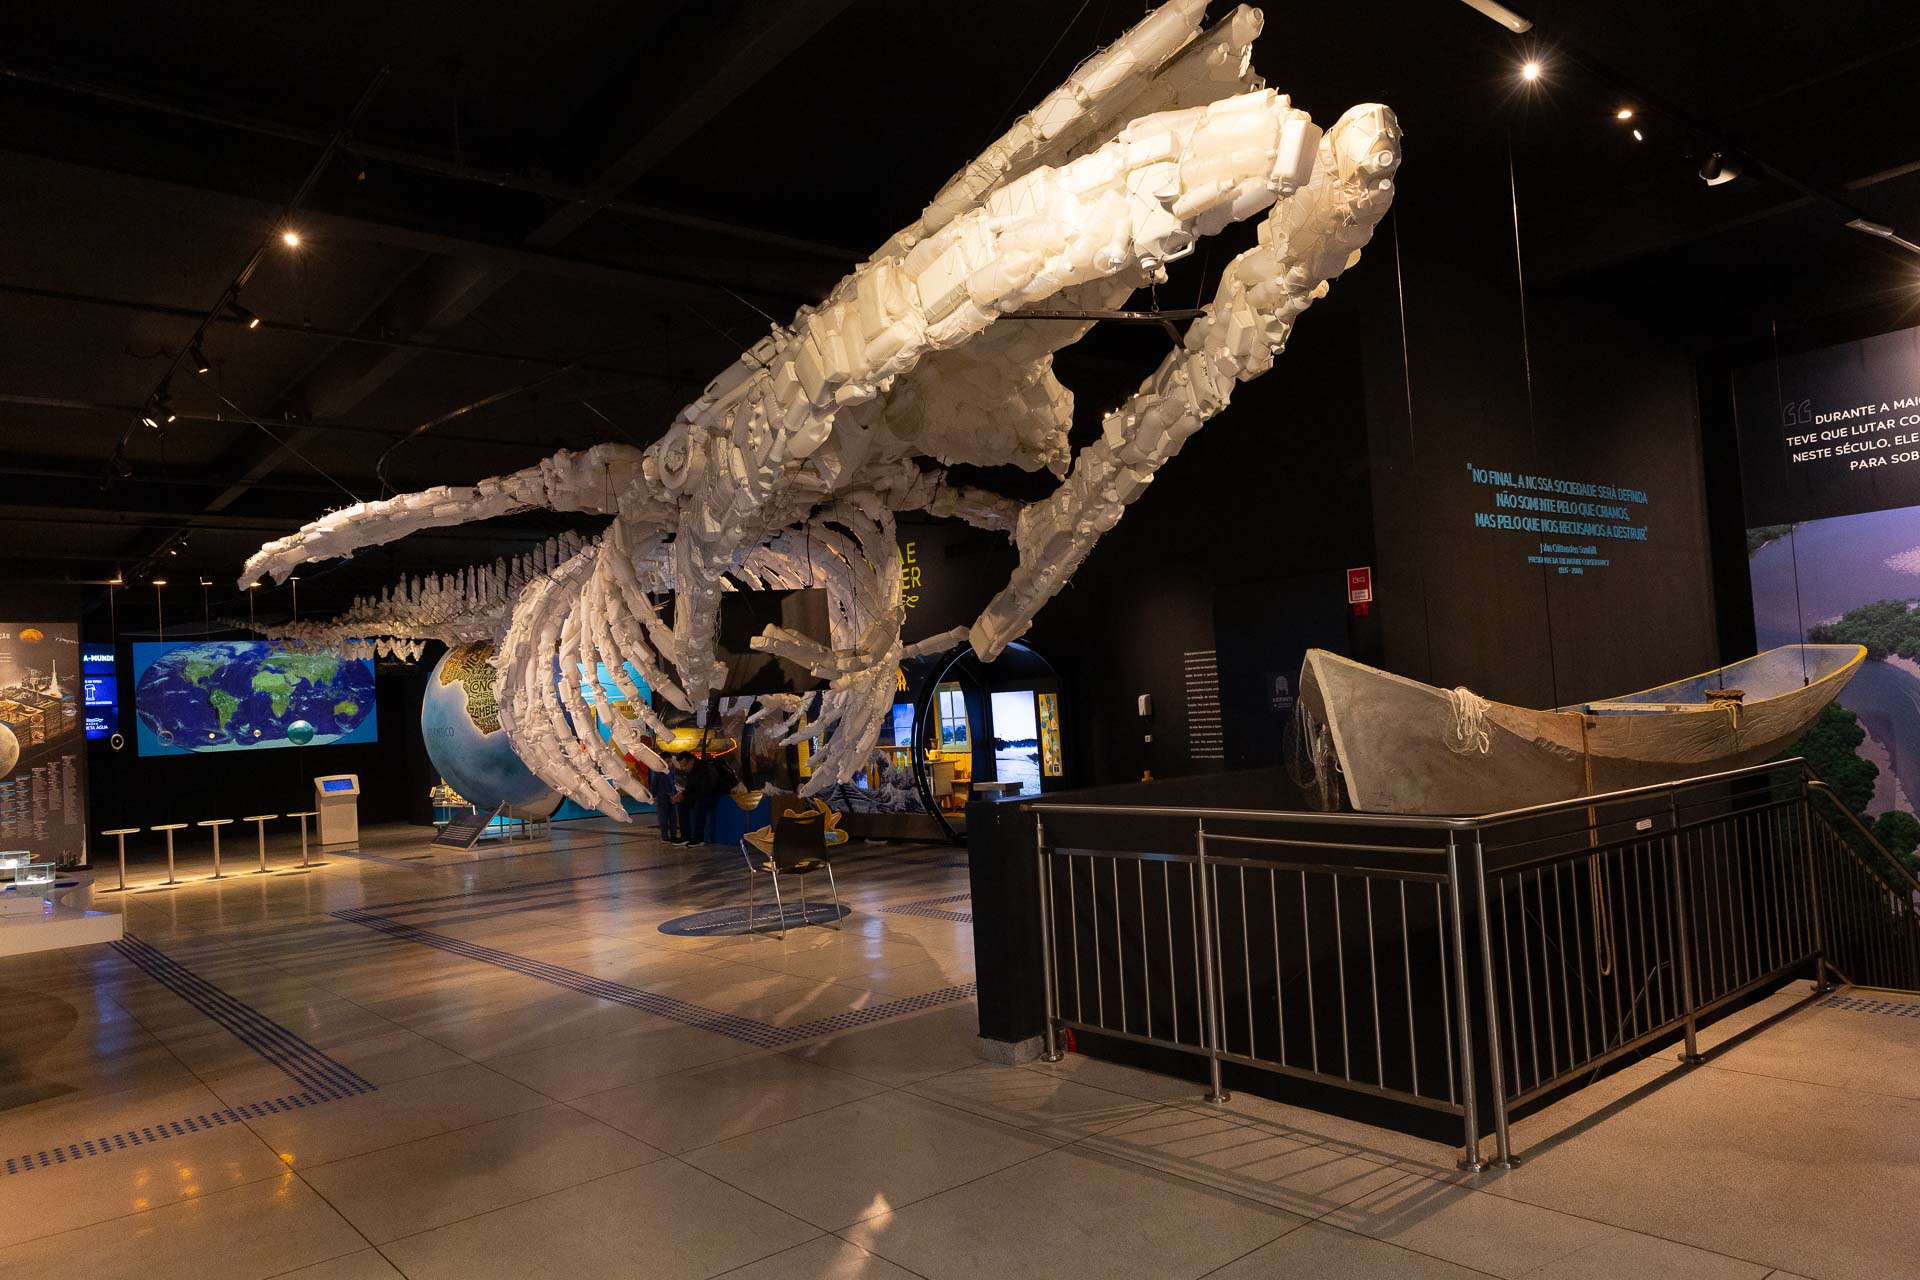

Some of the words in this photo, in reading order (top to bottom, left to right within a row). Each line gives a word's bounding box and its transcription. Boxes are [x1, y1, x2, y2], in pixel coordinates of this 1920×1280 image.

[1815, 404, 1876, 425] DURANTE
[1880, 402, 1890, 412] A
[1894, 396, 1920, 410] MAI
[1786, 432, 1818, 447] TEVE
[1821, 427, 1848, 441] QUE
[1852, 419, 1896, 436] LUTAR
[1792, 448, 1832, 463] NESTE
[1835, 438, 1891, 456] SÉCULO.
[1894, 432, 1919, 446] ELE
[1850, 456, 1888, 470] PARA
[1488, 470, 1517, 488] FINAL,
[1518, 474, 1526, 488] A
[1554, 479, 1598, 498] SOCIEDADE
[1598, 484, 1617, 500] SERÁ
[1618, 488, 1648, 504] DEFINIDA
[1496, 490, 1518, 508] NÃO
[1556, 500, 1578, 514] PELO
[1578, 502, 1596, 518] QUE
[1474, 512, 1496, 528] MAS
[1497, 515, 1522, 530] PELO
[1522, 517, 1540, 532] QUE
[1541, 518, 1558, 534] NOS
[1559, 521, 1606, 538] RECUSAMOS
[1606, 525, 1612, 538] A
